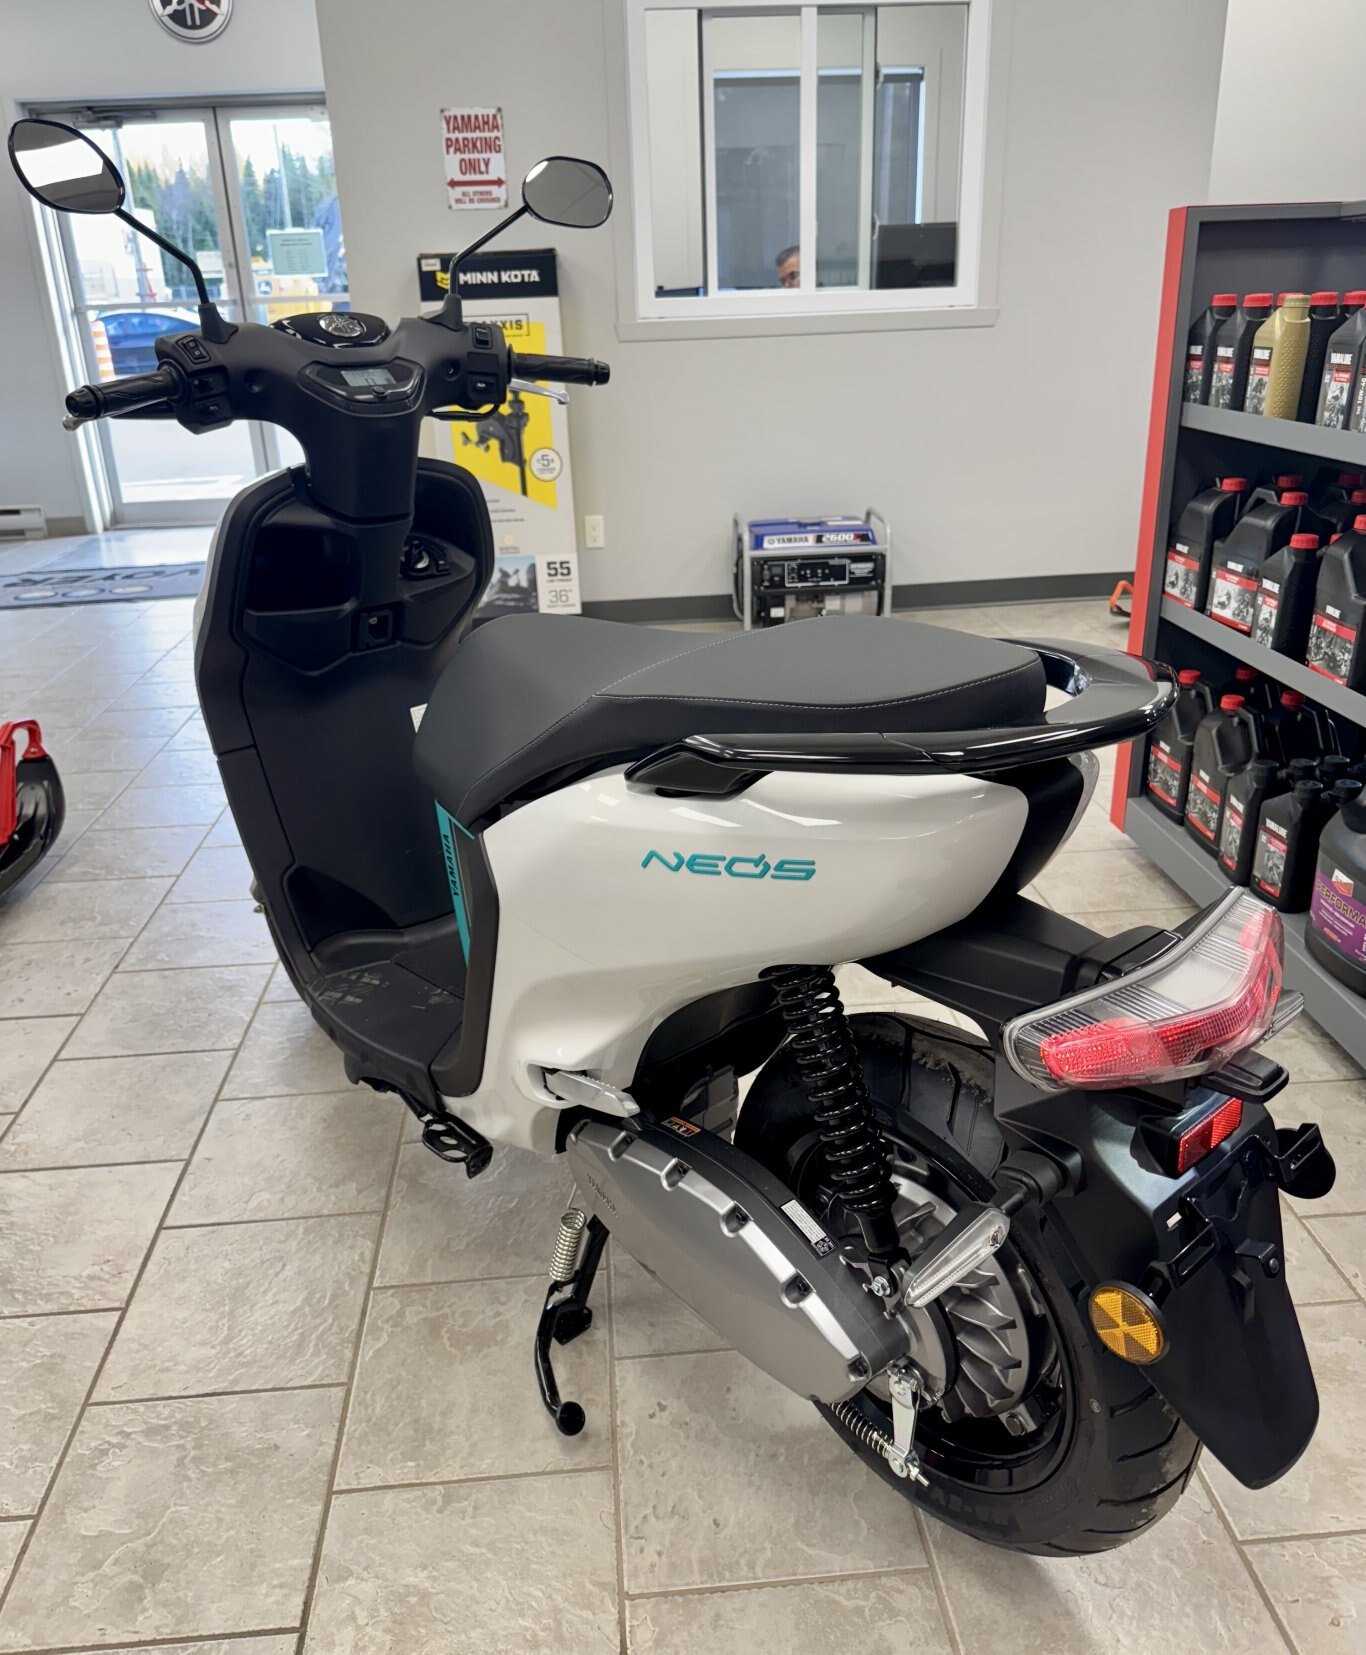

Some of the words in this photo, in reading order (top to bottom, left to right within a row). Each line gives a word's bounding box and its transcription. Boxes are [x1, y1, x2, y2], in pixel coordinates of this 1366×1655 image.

[444, 113, 500, 134] YAMAHA
[445, 135, 502, 155] PARKING
[459, 157, 490, 176] ONLY
[458, 271, 499, 286] MINN
[500, 269, 540, 284] KOTA
[776, 536, 809, 545] YAMAHA
[822, 532, 854, 542] 2600
[546, 561, 571, 577] 55
[442, 834, 459, 897] YAMAHA
